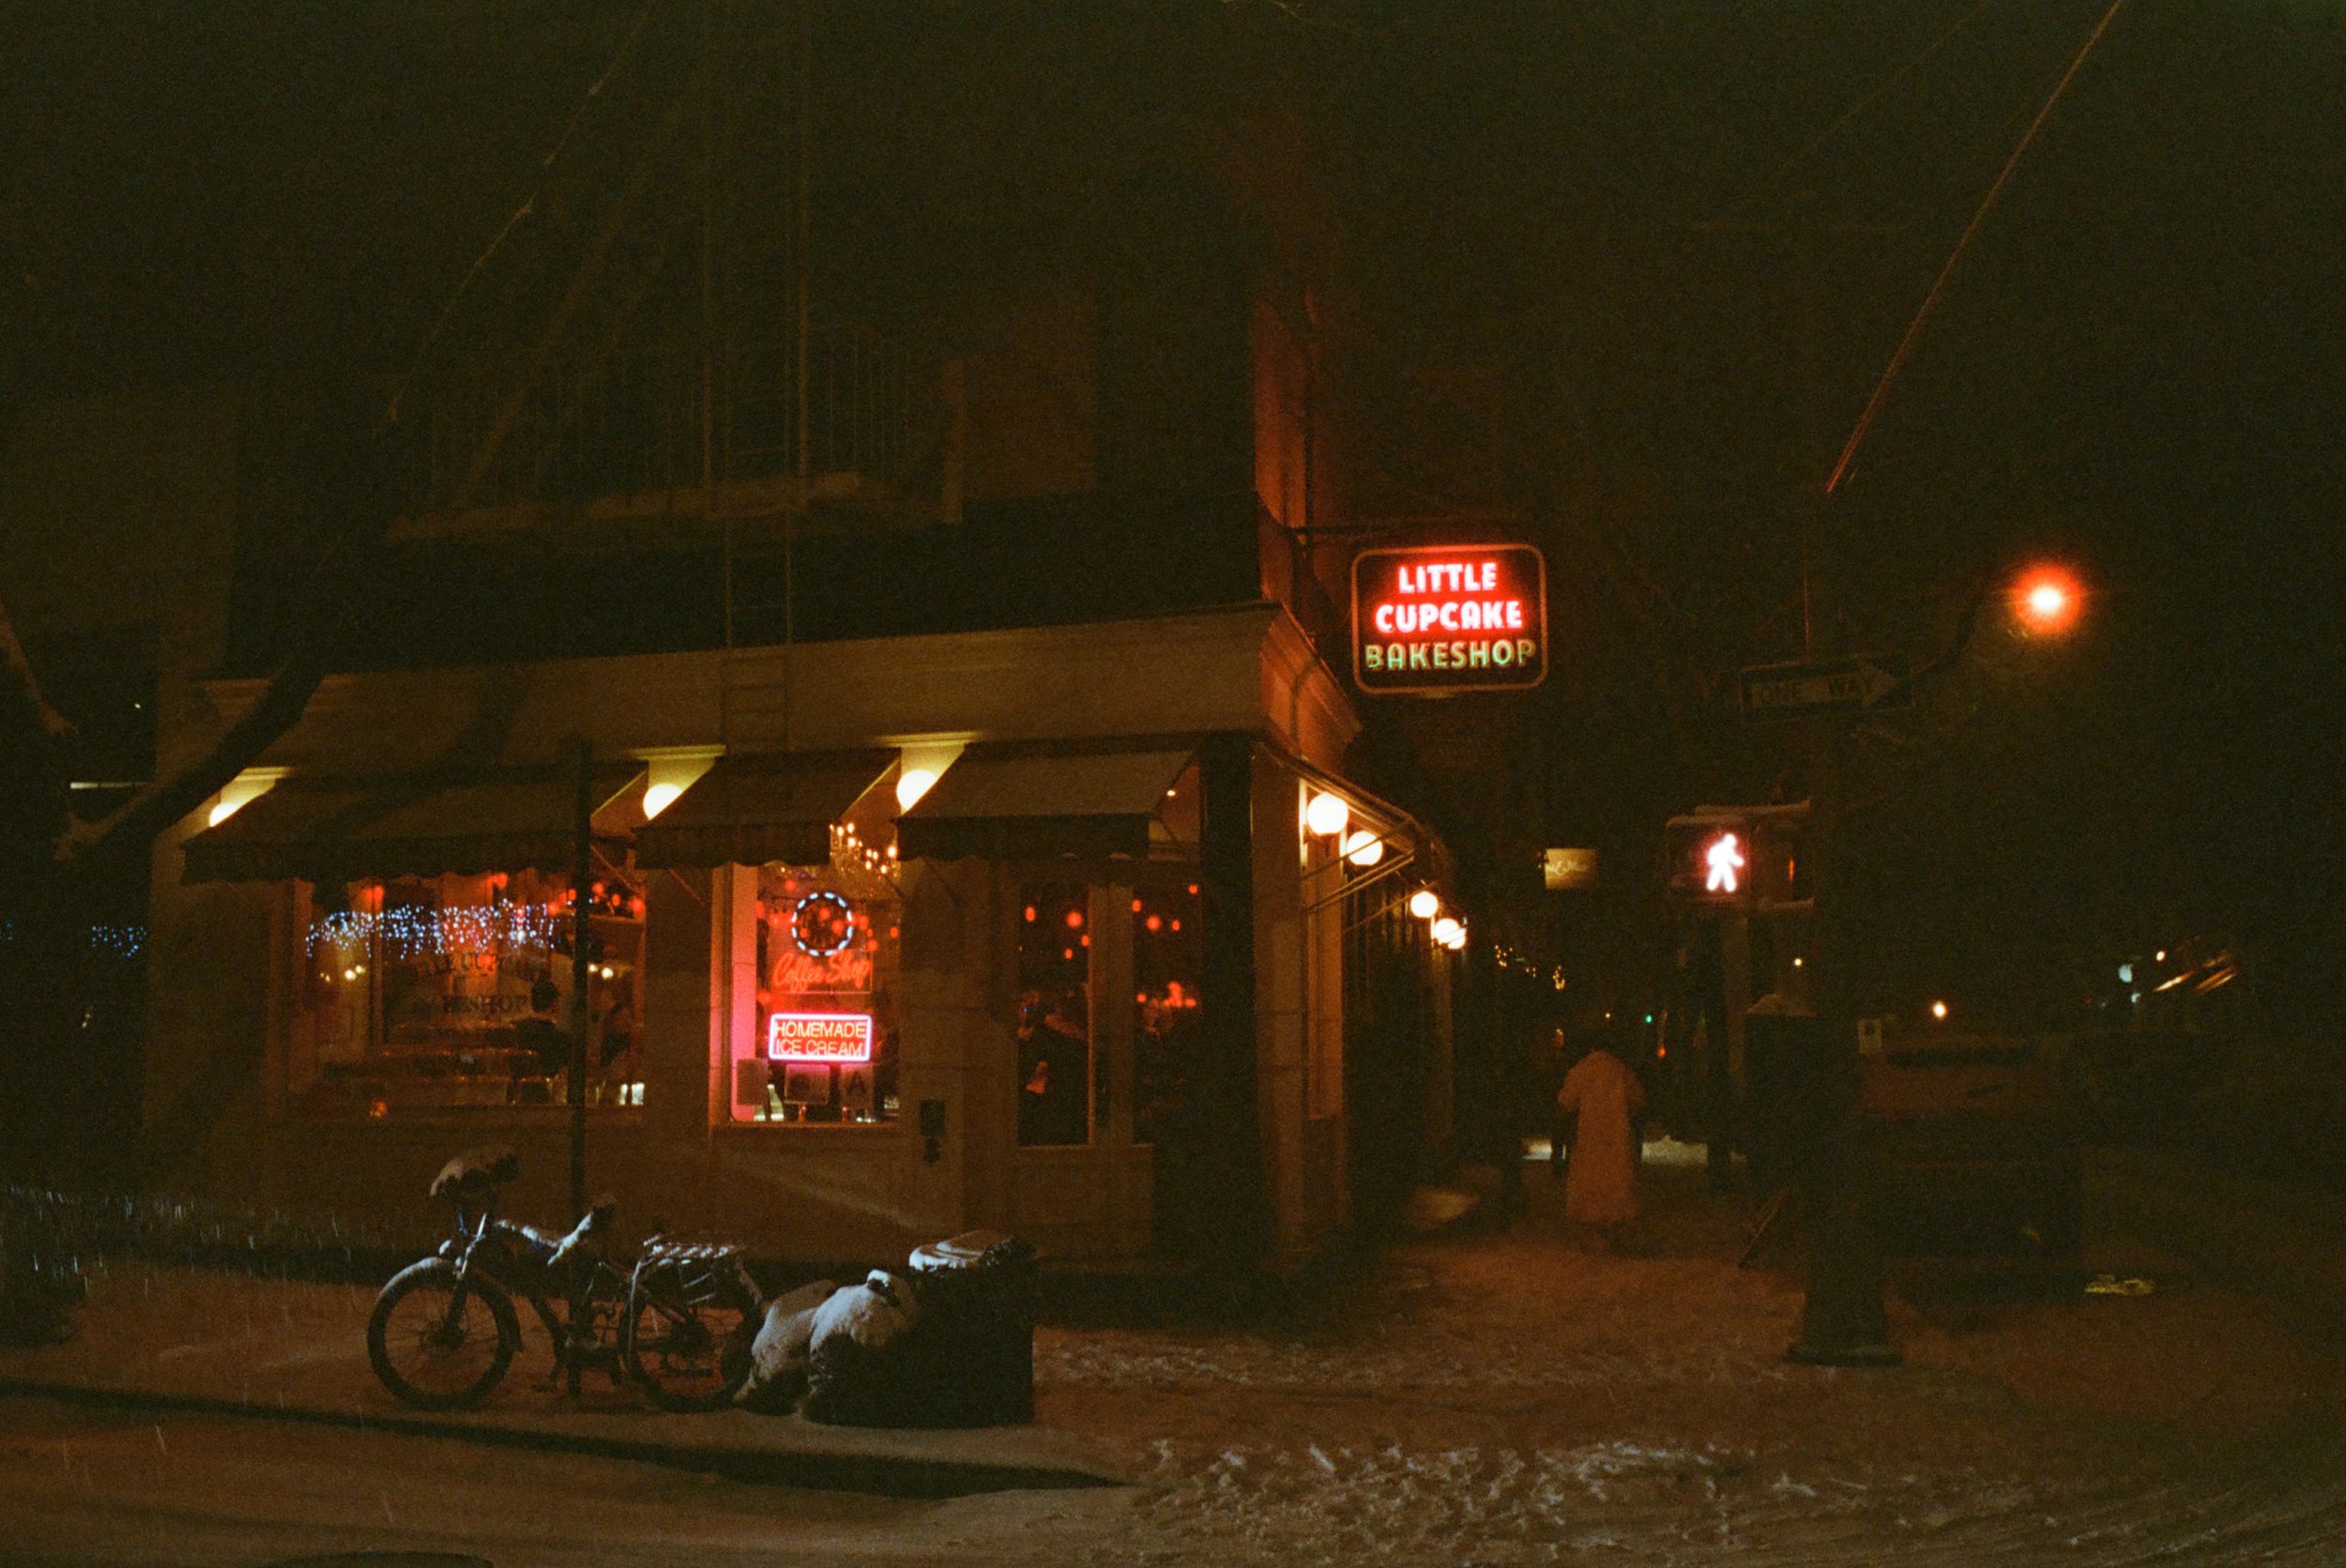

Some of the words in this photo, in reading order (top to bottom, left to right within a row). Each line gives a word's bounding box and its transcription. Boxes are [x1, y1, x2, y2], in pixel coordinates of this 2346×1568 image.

[1398, 562, 1497, 593] LITTLE
[1375, 600, 1523, 632] CUPCAKE
[1365, 639, 1536, 670] BAKESHOP
[773, 952, 823, 991] Coffee
[827, 950, 871, 989] Shop
[774, 1022, 867, 1039] HOMEMADE
[777, 1039, 801, 1055] ICE
[806, 1041, 862, 1057] CREAM
